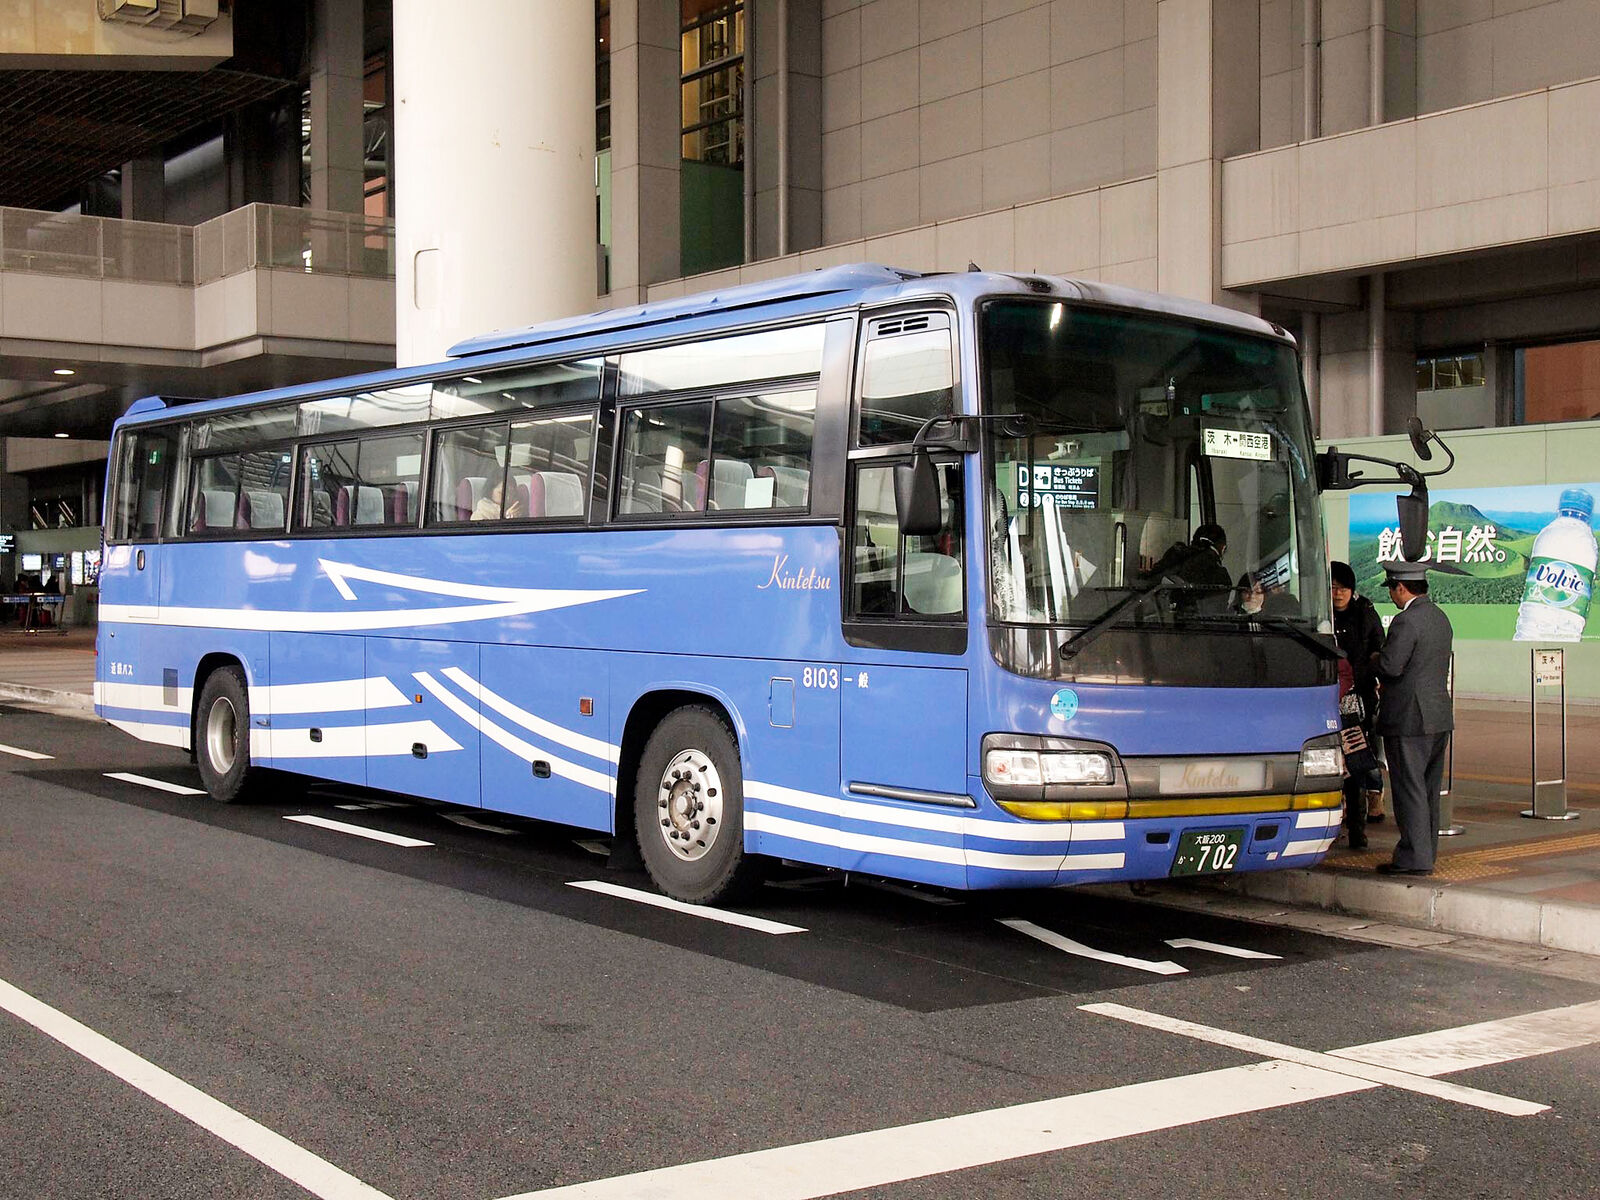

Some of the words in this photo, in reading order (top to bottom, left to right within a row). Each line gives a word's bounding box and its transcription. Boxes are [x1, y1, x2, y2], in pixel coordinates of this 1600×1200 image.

[1053, 476, 1064, 484] Bus
[757, 554, 831, 590] Kintetsu
[1536, 564, 1584, 592] Volvic
[802, 667, 839, 689] 8103
[1174, 762, 1241, 789] Kintetsu
